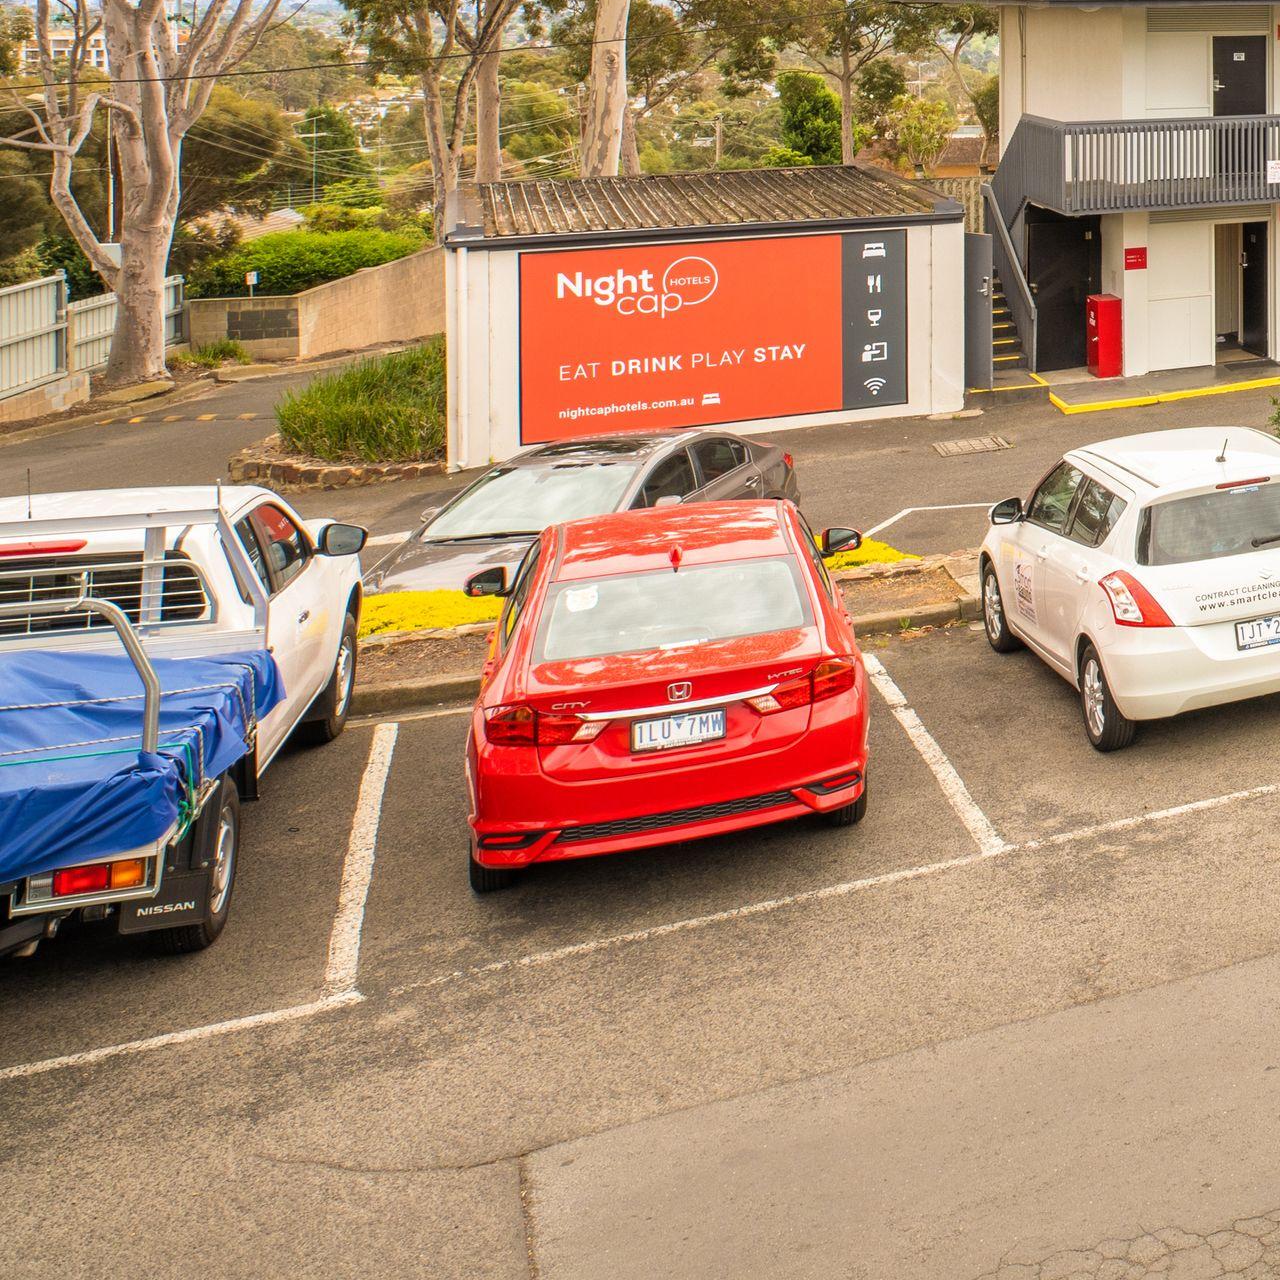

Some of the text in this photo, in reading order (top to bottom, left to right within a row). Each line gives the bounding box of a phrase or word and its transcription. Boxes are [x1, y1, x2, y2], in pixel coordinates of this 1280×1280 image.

[556, 269, 710, 306] Night HOTELS
[617, 293, 682, 319] cap
[559, 344, 806, 381] EAT DRINK PLAY STAY
[559, 397, 694, 419] nightcaphotels.com.au
[1195, 588, 1239, 602] CONTRACT
[1242, 580, 1280, 594] CLEANING
[1241, 622, 1262, 641] 1JT
[552, 701, 591, 710] CITY
[638, 714, 723, 743] 1LU 7MW
[136, 901, 195, 917] NISSAN
